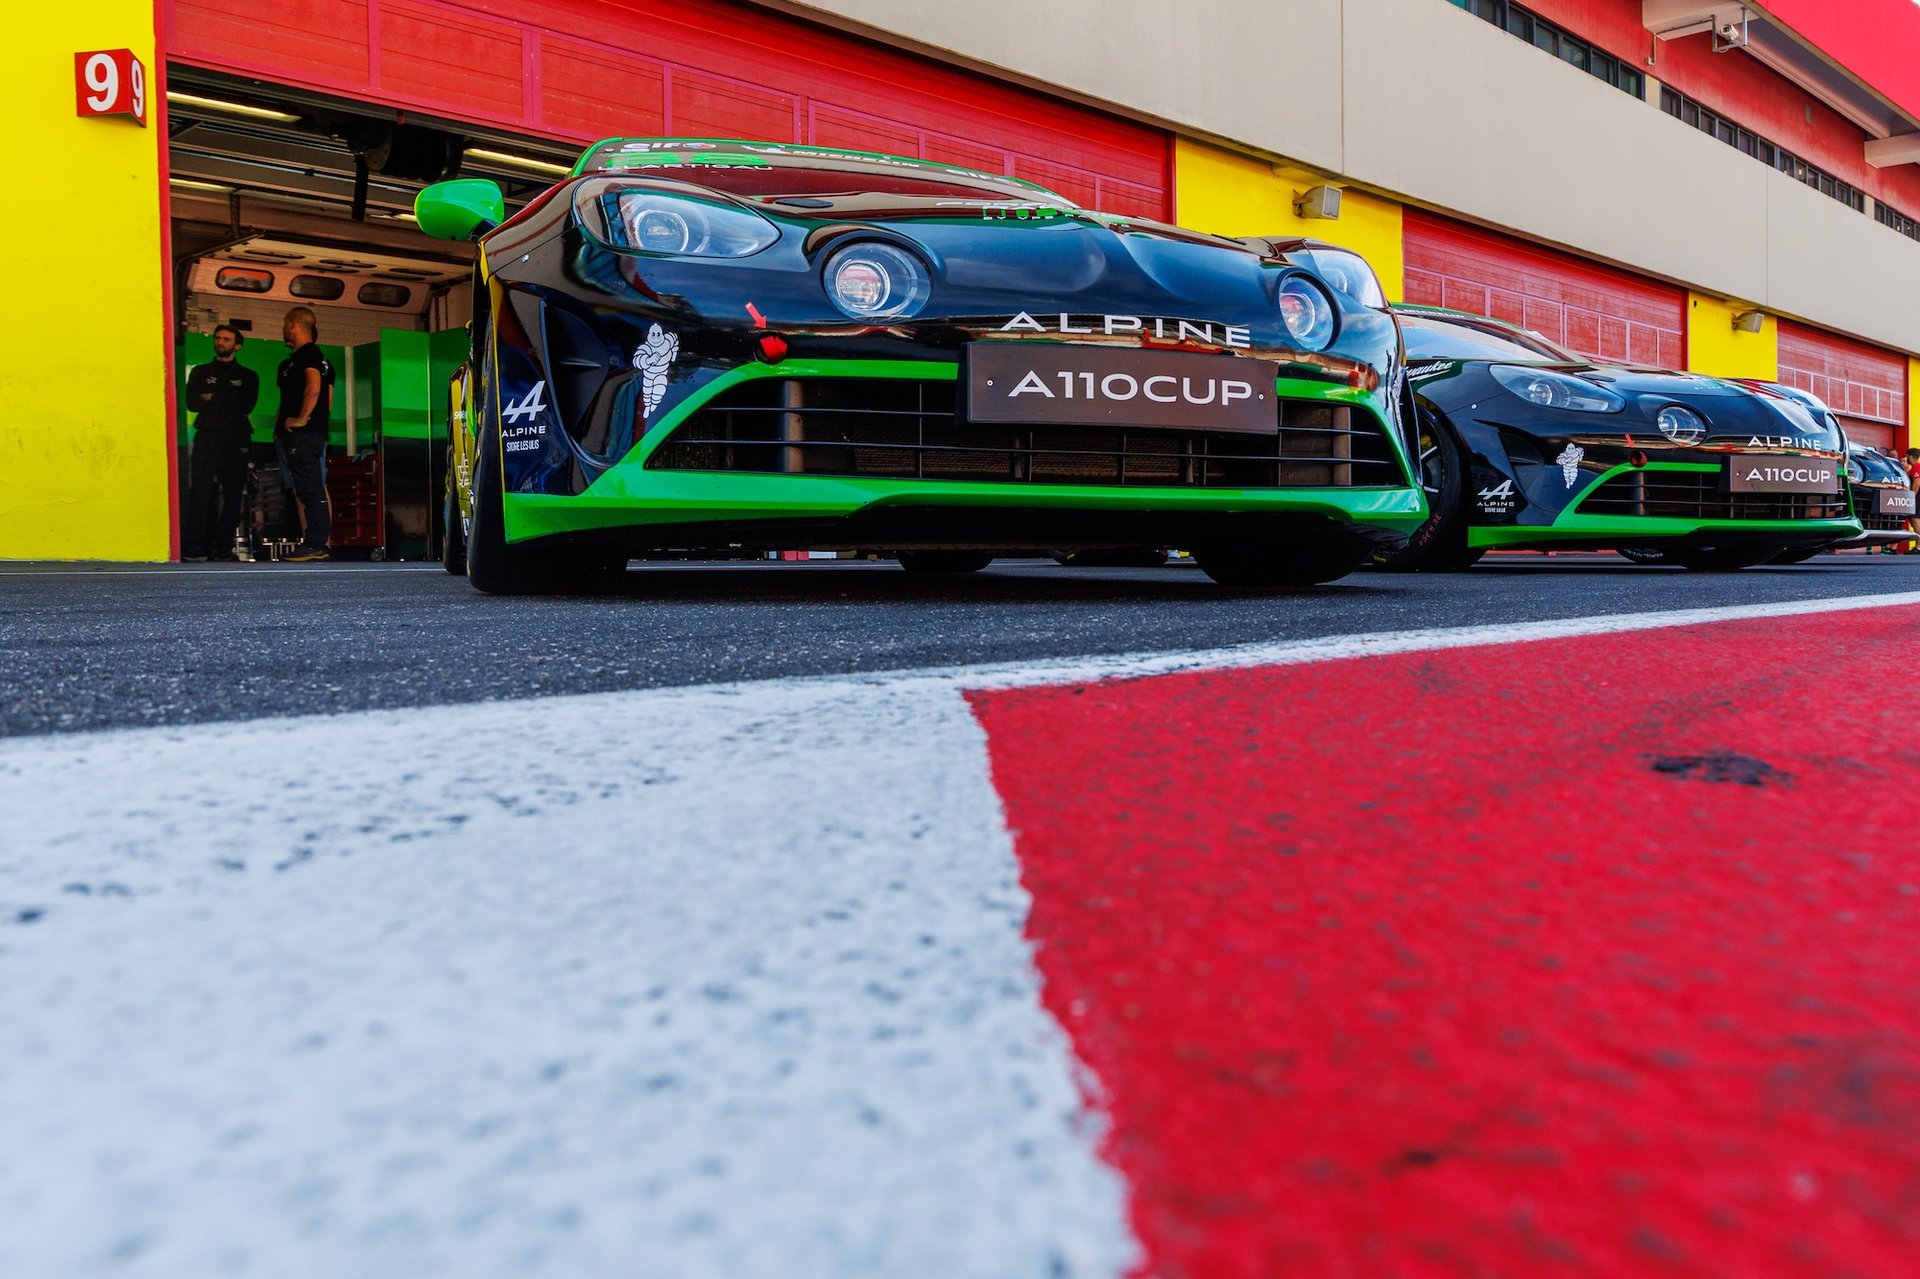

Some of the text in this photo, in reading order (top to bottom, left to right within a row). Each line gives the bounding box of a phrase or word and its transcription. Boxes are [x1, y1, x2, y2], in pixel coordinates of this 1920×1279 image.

[84, 53, 119, 112] 9
[131, 59, 144, 118] 9
[1000, 310, 1251, 349] ALPINE
[1405, 360, 1453, 377] waukee
[1007, 369, 1252, 407] A110CUP
[501, 425, 547, 438] ALPINE
[506, 441, 520, 453] STORE
[1747, 435, 1821, 451] ALPINE
[1745, 467, 1831, 483] A110CUP
